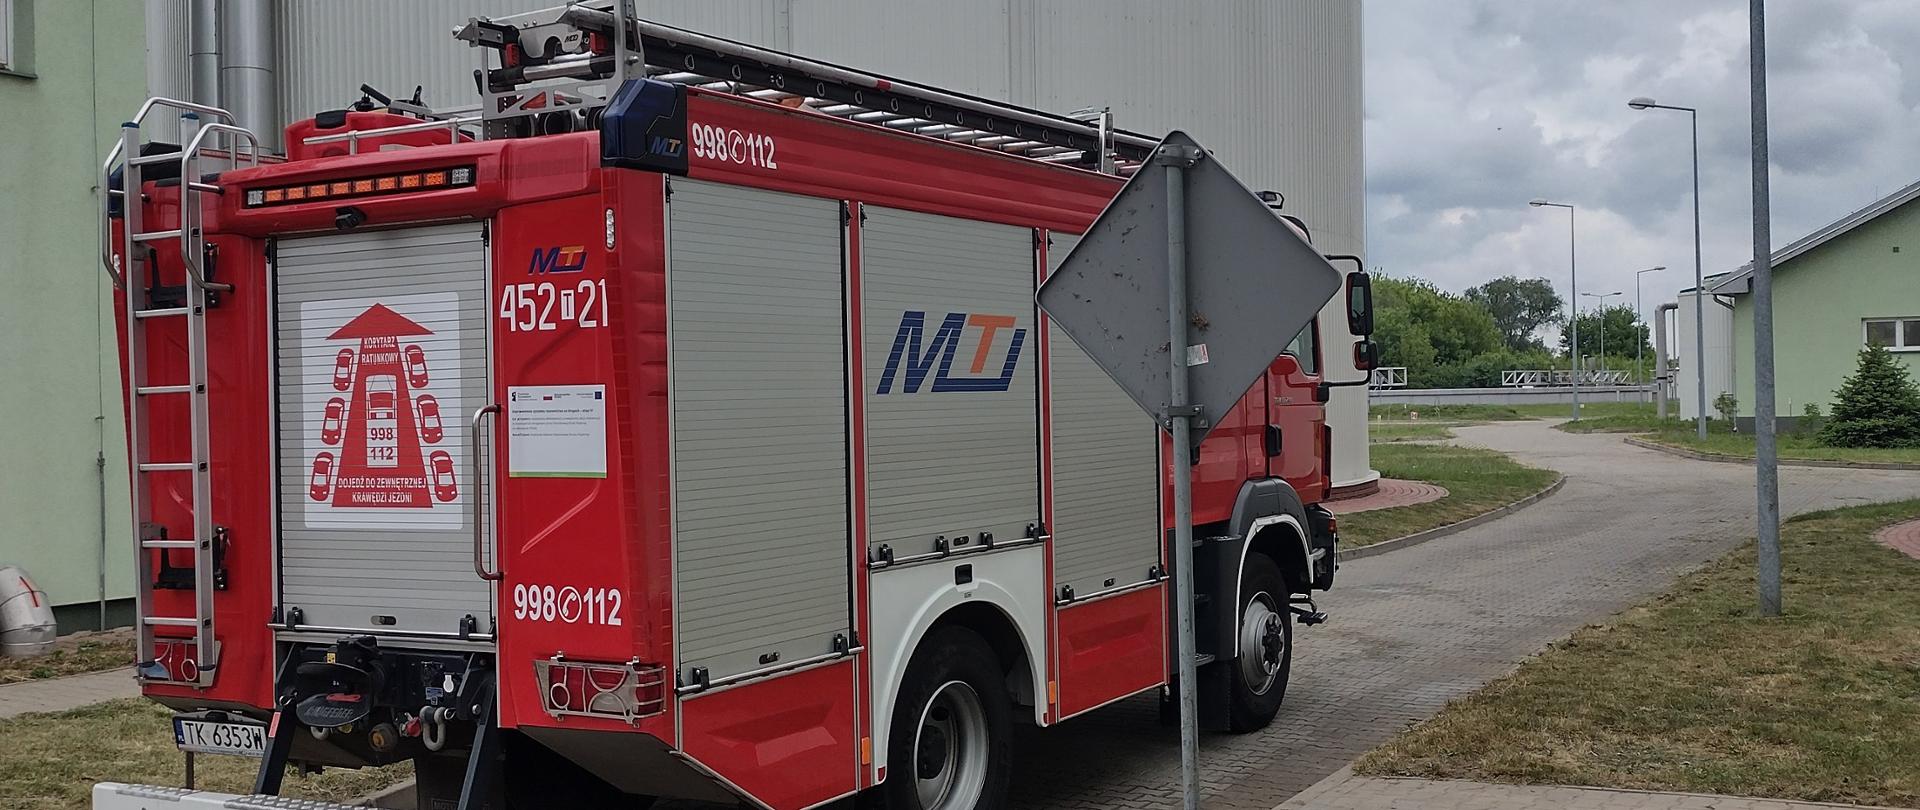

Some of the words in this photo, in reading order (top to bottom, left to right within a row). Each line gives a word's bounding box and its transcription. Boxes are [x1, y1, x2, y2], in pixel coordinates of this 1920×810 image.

[692, 122, 728, 161] 998
[747, 133, 777, 169] 112
[363, 336, 396, 349] KORYTARZ
[362, 353, 398, 364] RATUNKOWY
[370, 427, 394, 441] 998
[370, 446, 394, 460] 112
[365, 477, 376, 488] DO
[376, 477, 427, 491] ZEWNĘTRZNEJ
[387, 491, 413, 503] JEZDNI
[514, 583, 556, 622] 998
[584, 587, 622, 626] 112
[185, 722, 207, 746] TK
[213, 724, 264, 750] 6353W
